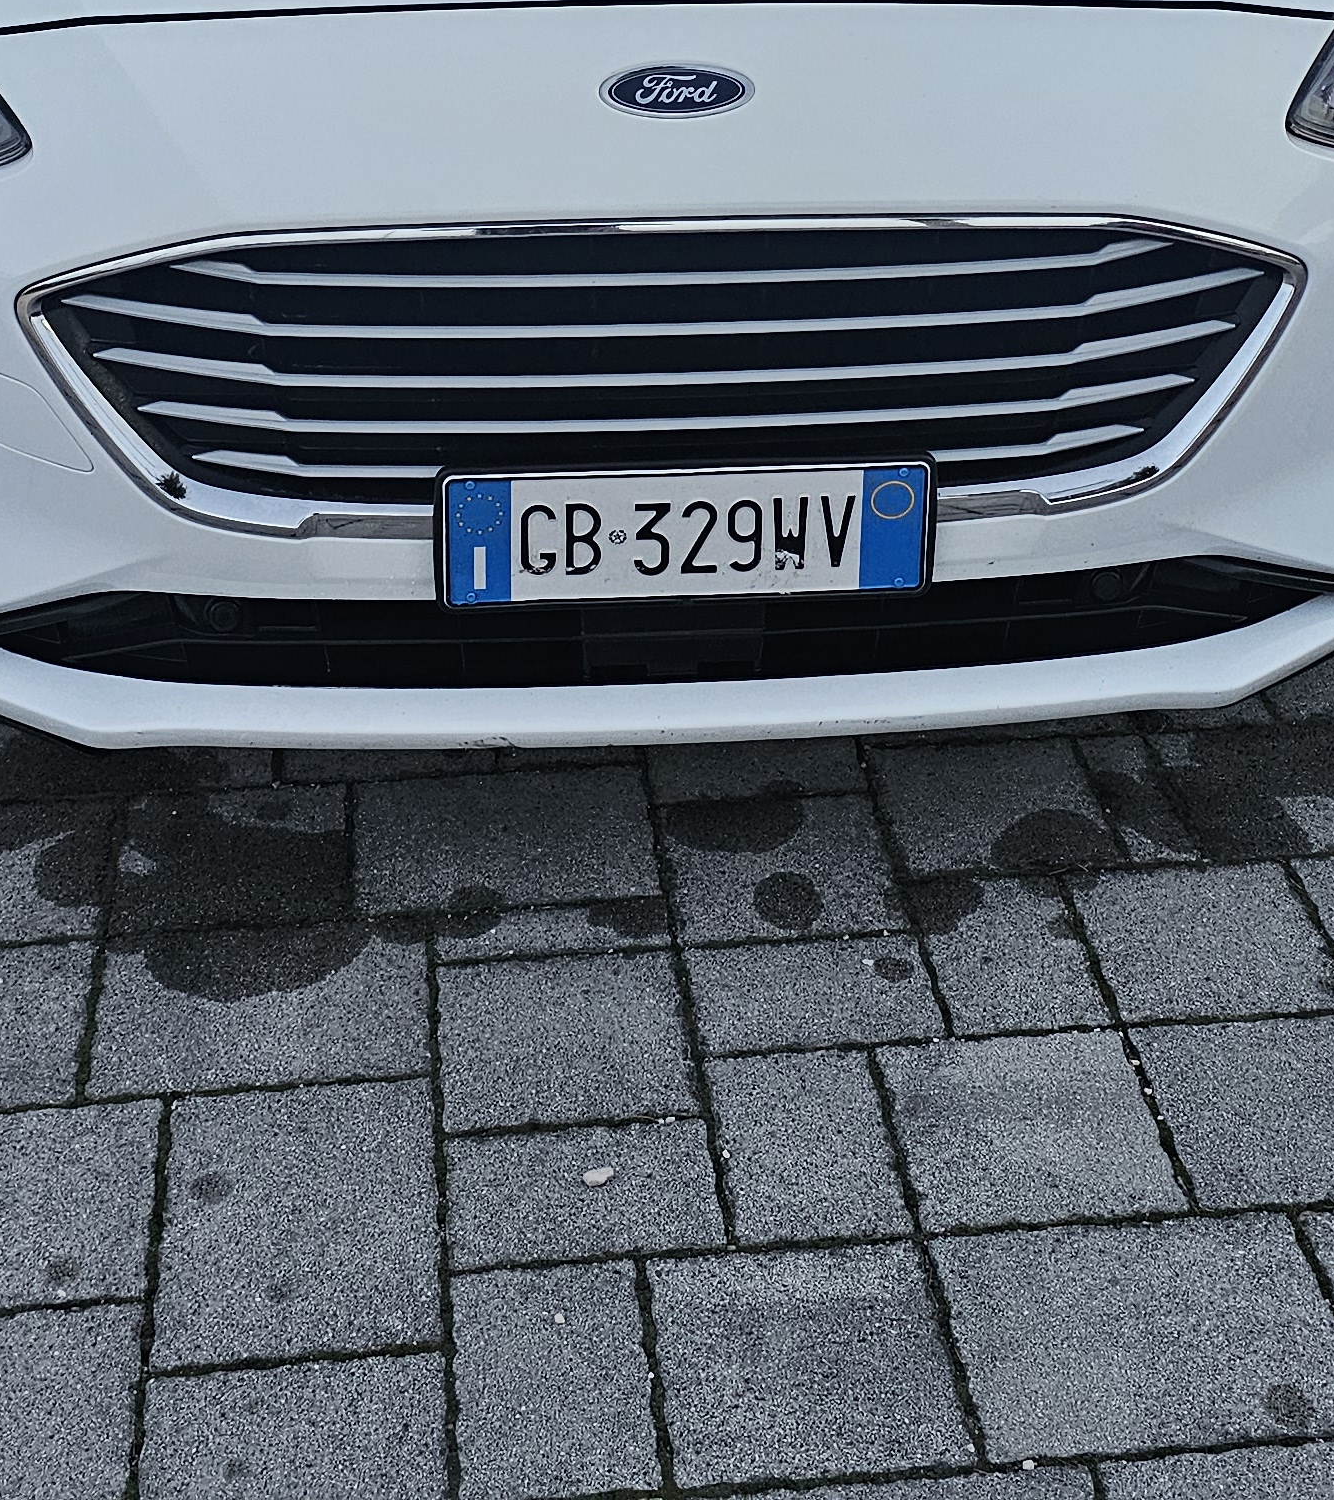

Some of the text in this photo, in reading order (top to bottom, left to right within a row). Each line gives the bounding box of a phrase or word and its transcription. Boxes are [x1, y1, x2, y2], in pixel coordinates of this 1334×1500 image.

[635, 74, 718, 105] Ford
[519, 494, 857, 576] GB 329WV
